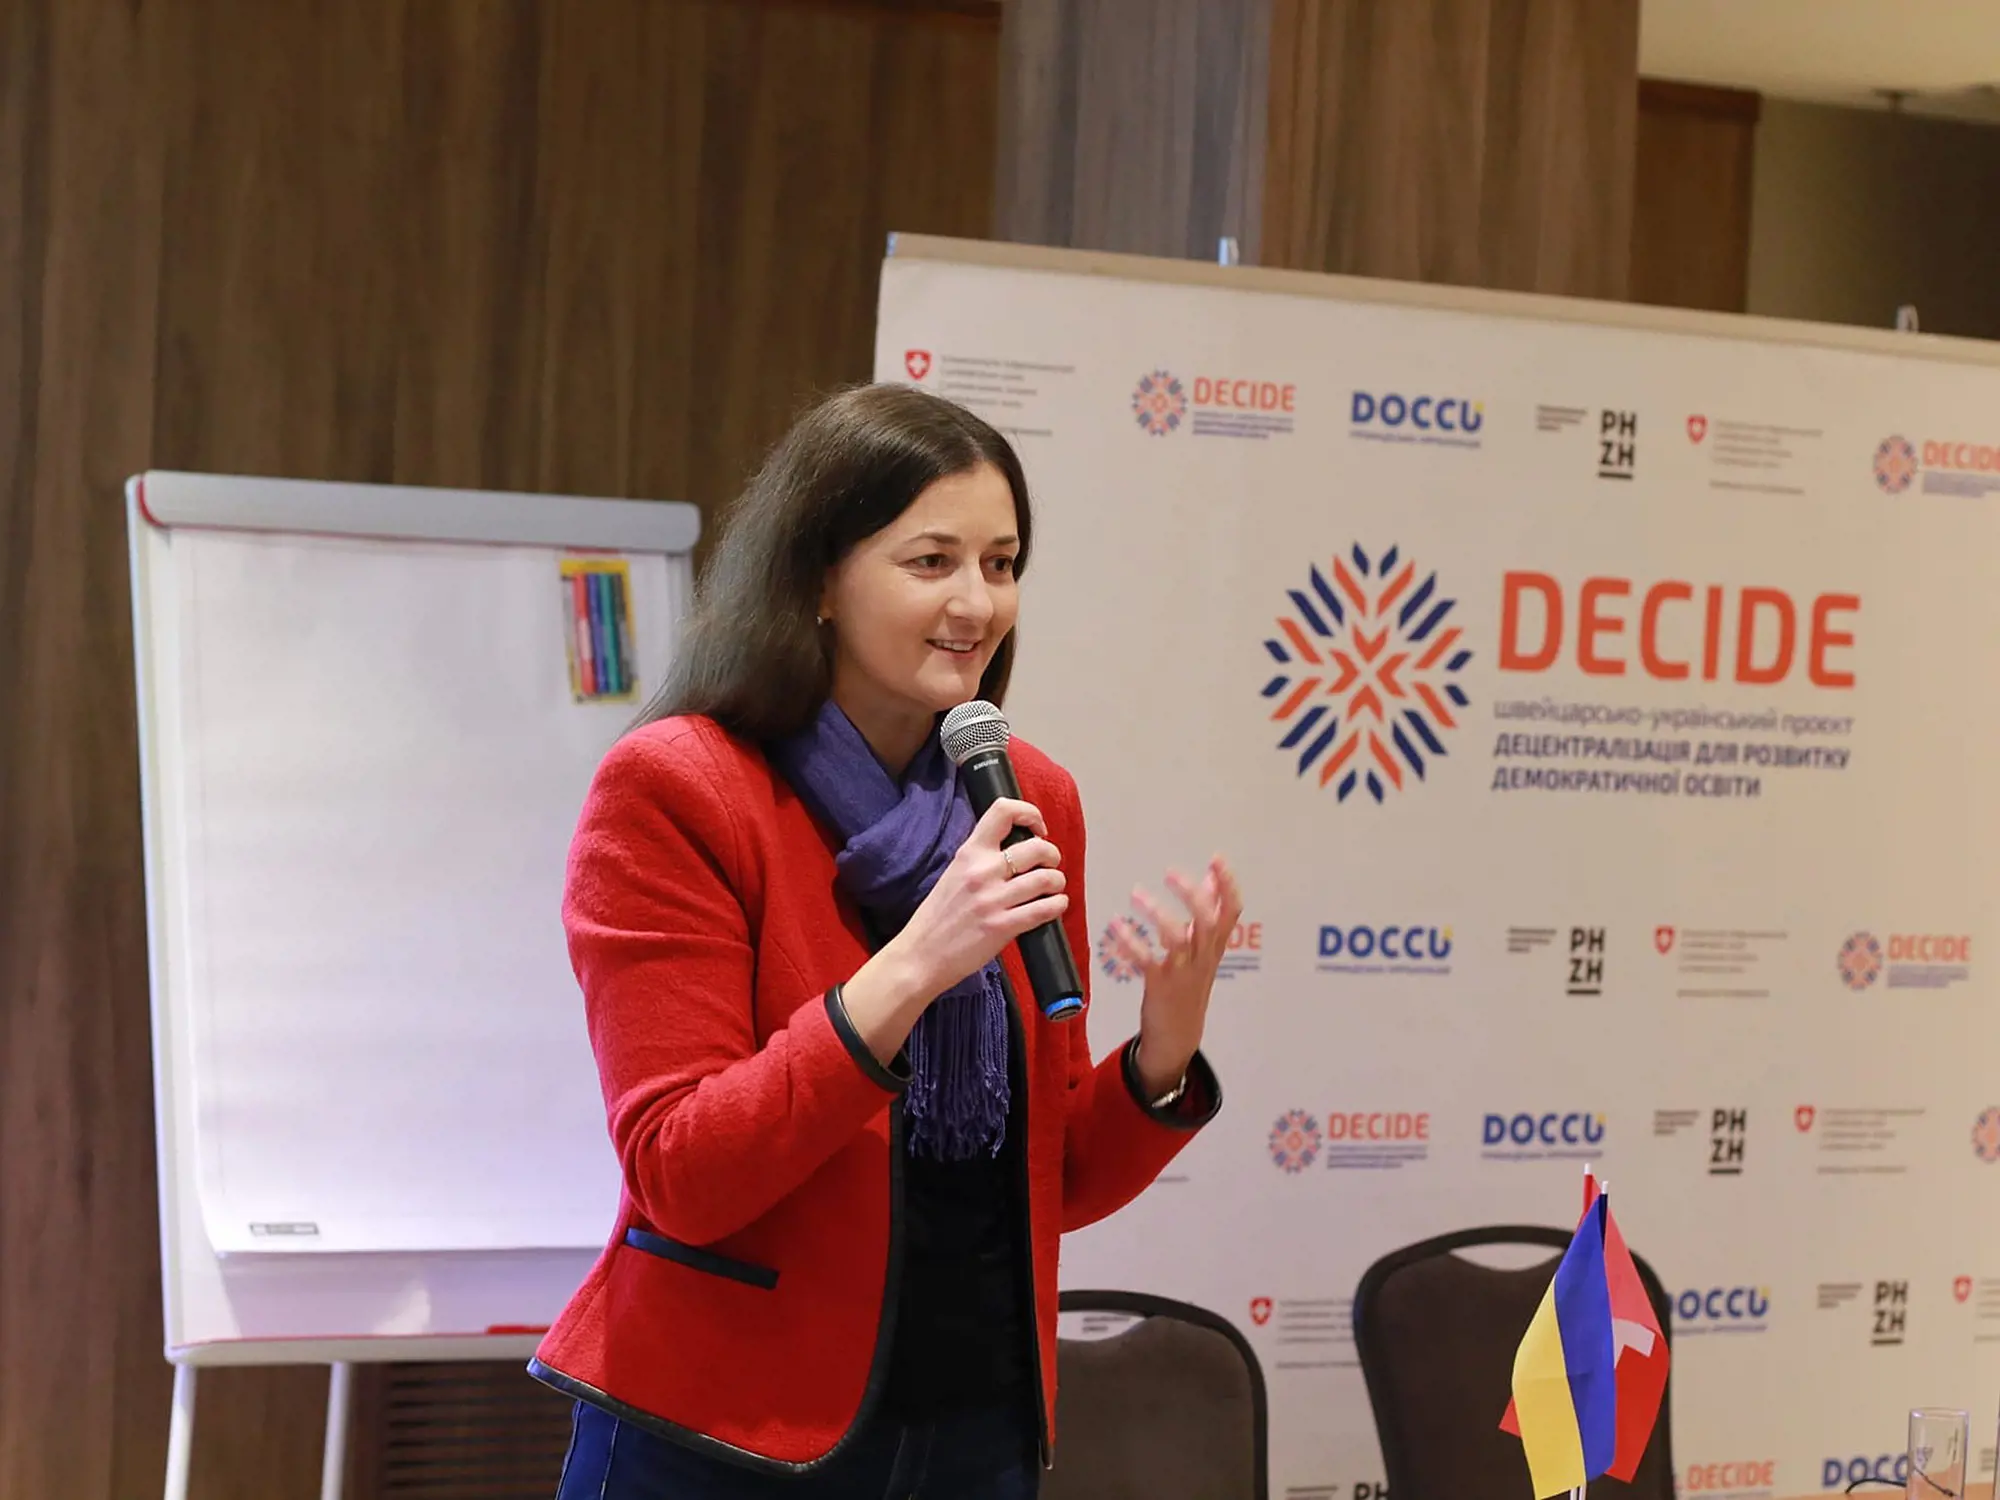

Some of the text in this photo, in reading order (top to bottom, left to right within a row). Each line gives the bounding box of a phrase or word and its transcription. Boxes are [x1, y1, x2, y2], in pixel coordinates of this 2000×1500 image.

[1193, 376, 1297, 413] DECIDE
[1351, 391, 1484, 433] DOCCU
[1601, 410, 1636, 437] PH
[1599, 440, 1635, 468] ZH
[1498, 569, 1861, 690] DECIDE
[1694, 741, 1739, 766] ДЛЯ
[1684, 773, 1761, 798] ОСВІТИ
[1319, 925, 1453, 959] DOCCU
[1570, 927, 1606, 953] PH
[1889, 934, 1971, 962] DECIDE
[1569, 957, 1604, 984] ZH
[1328, 1112, 1431, 1141] DECIDE
[1482, 1112, 1605, 1145] DOCCU
[1712, 1108, 1746, 1133] PH
[1710, 1137, 1743, 1164] ZH
[1874, 1281, 1909, 1305] PH
[1872, 1309, 1905, 1334] ZH
[1687, 1460, 1775, 1490] DECIDE
